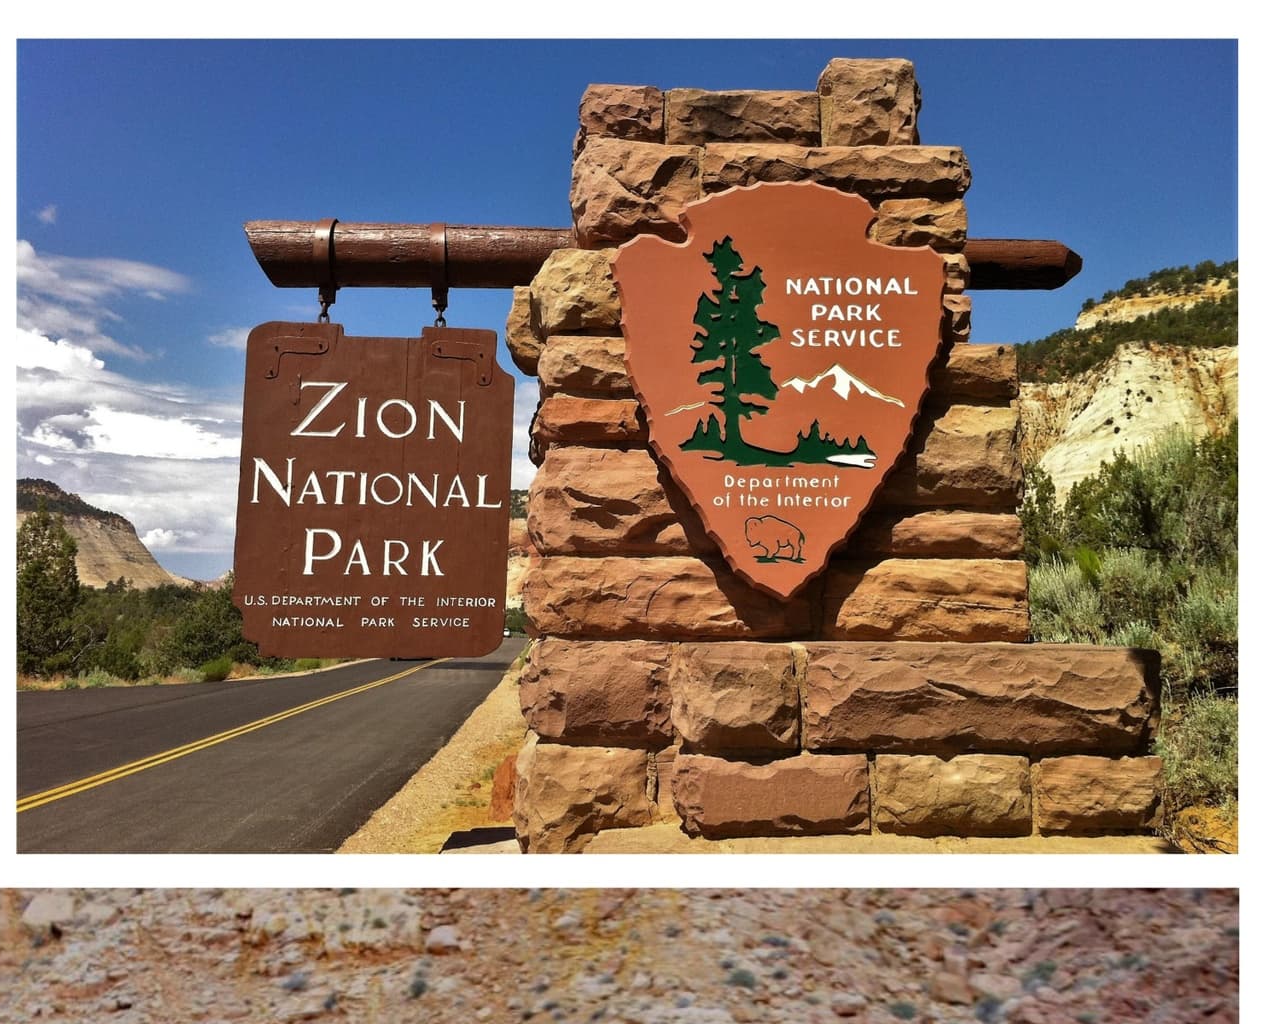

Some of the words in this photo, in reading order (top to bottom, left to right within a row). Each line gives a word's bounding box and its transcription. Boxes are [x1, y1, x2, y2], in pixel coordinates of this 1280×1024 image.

[785, 276, 919, 296] NATIONAL
[811, 303, 882, 322] PARK
[790, 328, 902, 348] SERVICE
[290, 381, 466, 443] ZION
[250, 457, 503, 508] NATIONAL
[723, 474, 840, 492] Department
[713, 493, 732, 508] of
[740, 494, 769, 508] the
[777, 494, 852, 508] Interior
[302, 528, 445, 576] PARK
[244, 595, 268, 606] U.S.
[271, 595, 361, 607] DEPARTMENT
[371, 596, 389, 607] OF
[400, 596, 425, 607] THE
[436, 597, 496, 607] INTERIOR
[272, 617, 344, 627] NATIONAL
[361, 617, 395, 627] PARK
[412, 617, 470, 627] SERVICE
